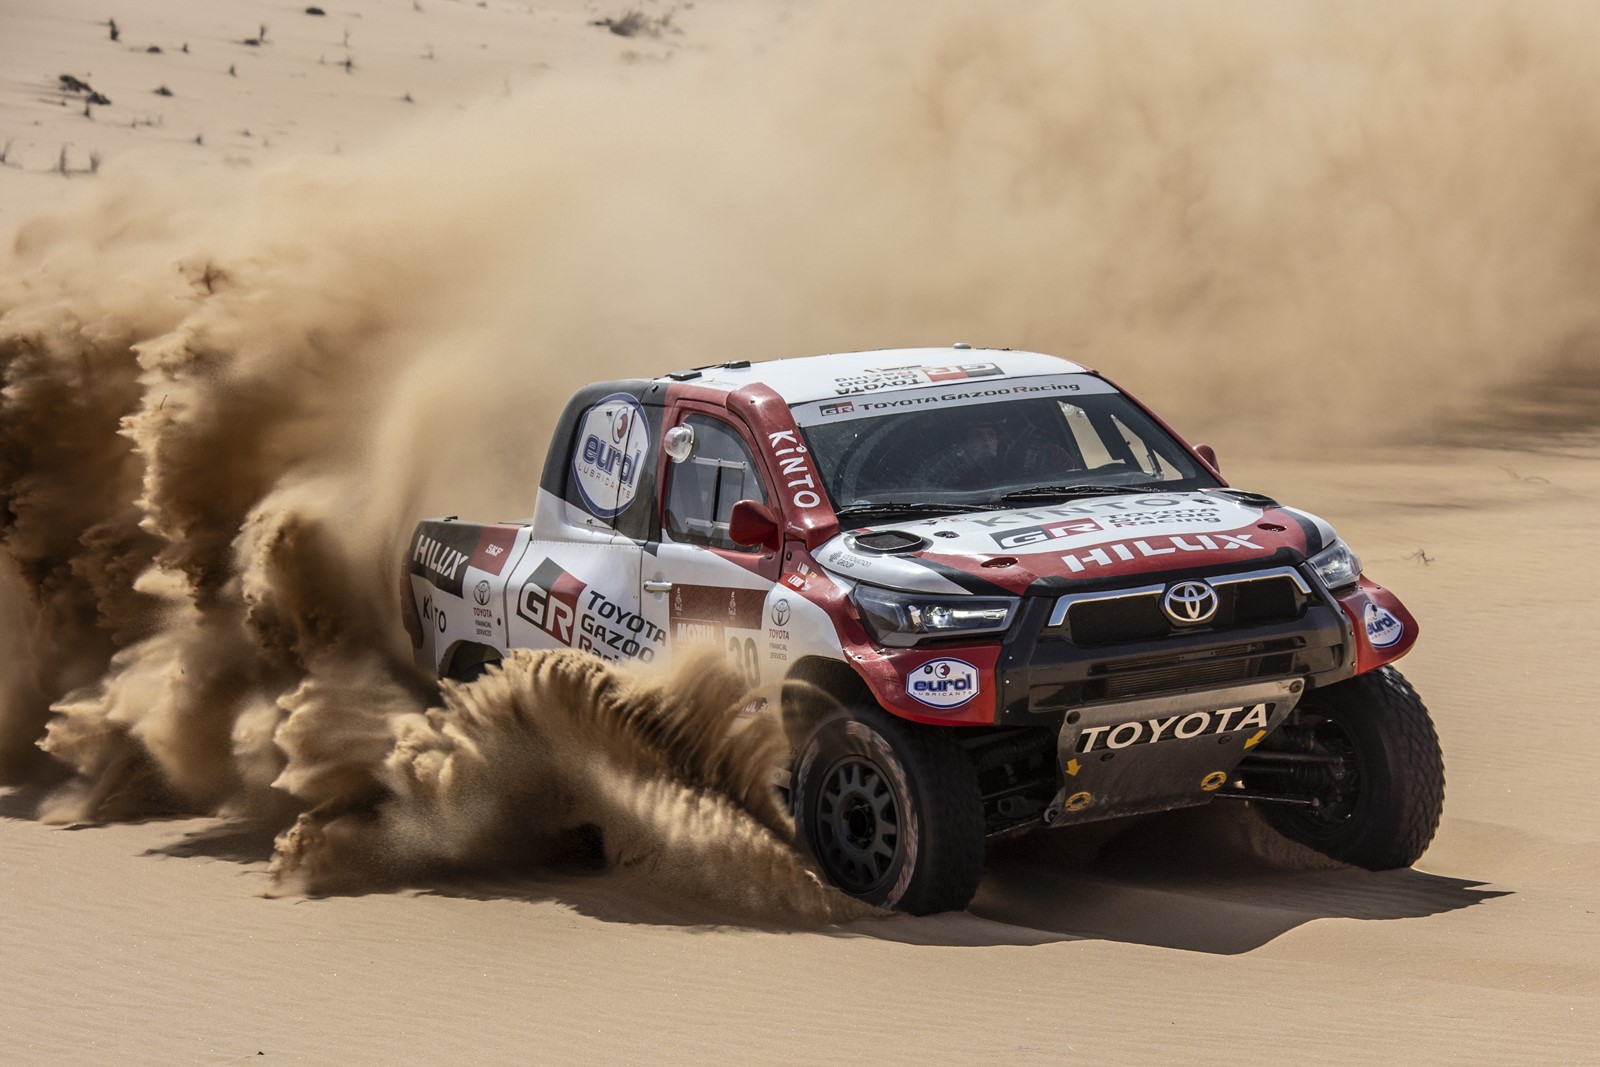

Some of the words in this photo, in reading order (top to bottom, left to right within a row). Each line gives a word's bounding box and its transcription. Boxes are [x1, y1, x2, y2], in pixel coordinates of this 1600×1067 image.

[820, 404, 854, 416] GR
[859, 396, 938, 410] TOYOTA
[941, 389, 1010, 401] GAZOO
[1013, 384, 1080, 394] Racing
[835, 379, 924, 395] TOYOTA
[583, 434, 641, 488] eurol
[1101, 508, 1220, 519] TOYOTA
[1109, 512, 1215, 523] GAZOO
[1114, 518, 1221, 528] Racing
[996, 520, 1102, 549] GR
[413, 534, 469, 580] HILUX
[485, 544, 504, 557] SKF
[1061, 534, 1264, 573] HILUX
[473, 607, 492, 618] TOYOTA
[519, 582, 574, 643] GR
[587, 590, 667, 647] TOYOTA
[581, 613, 655, 664] GAZOO
[768, 629, 789, 640] TOYOTA
[913, 673, 972, 692] eurol
[1080, 703, 1268, 753] TOYOTA
